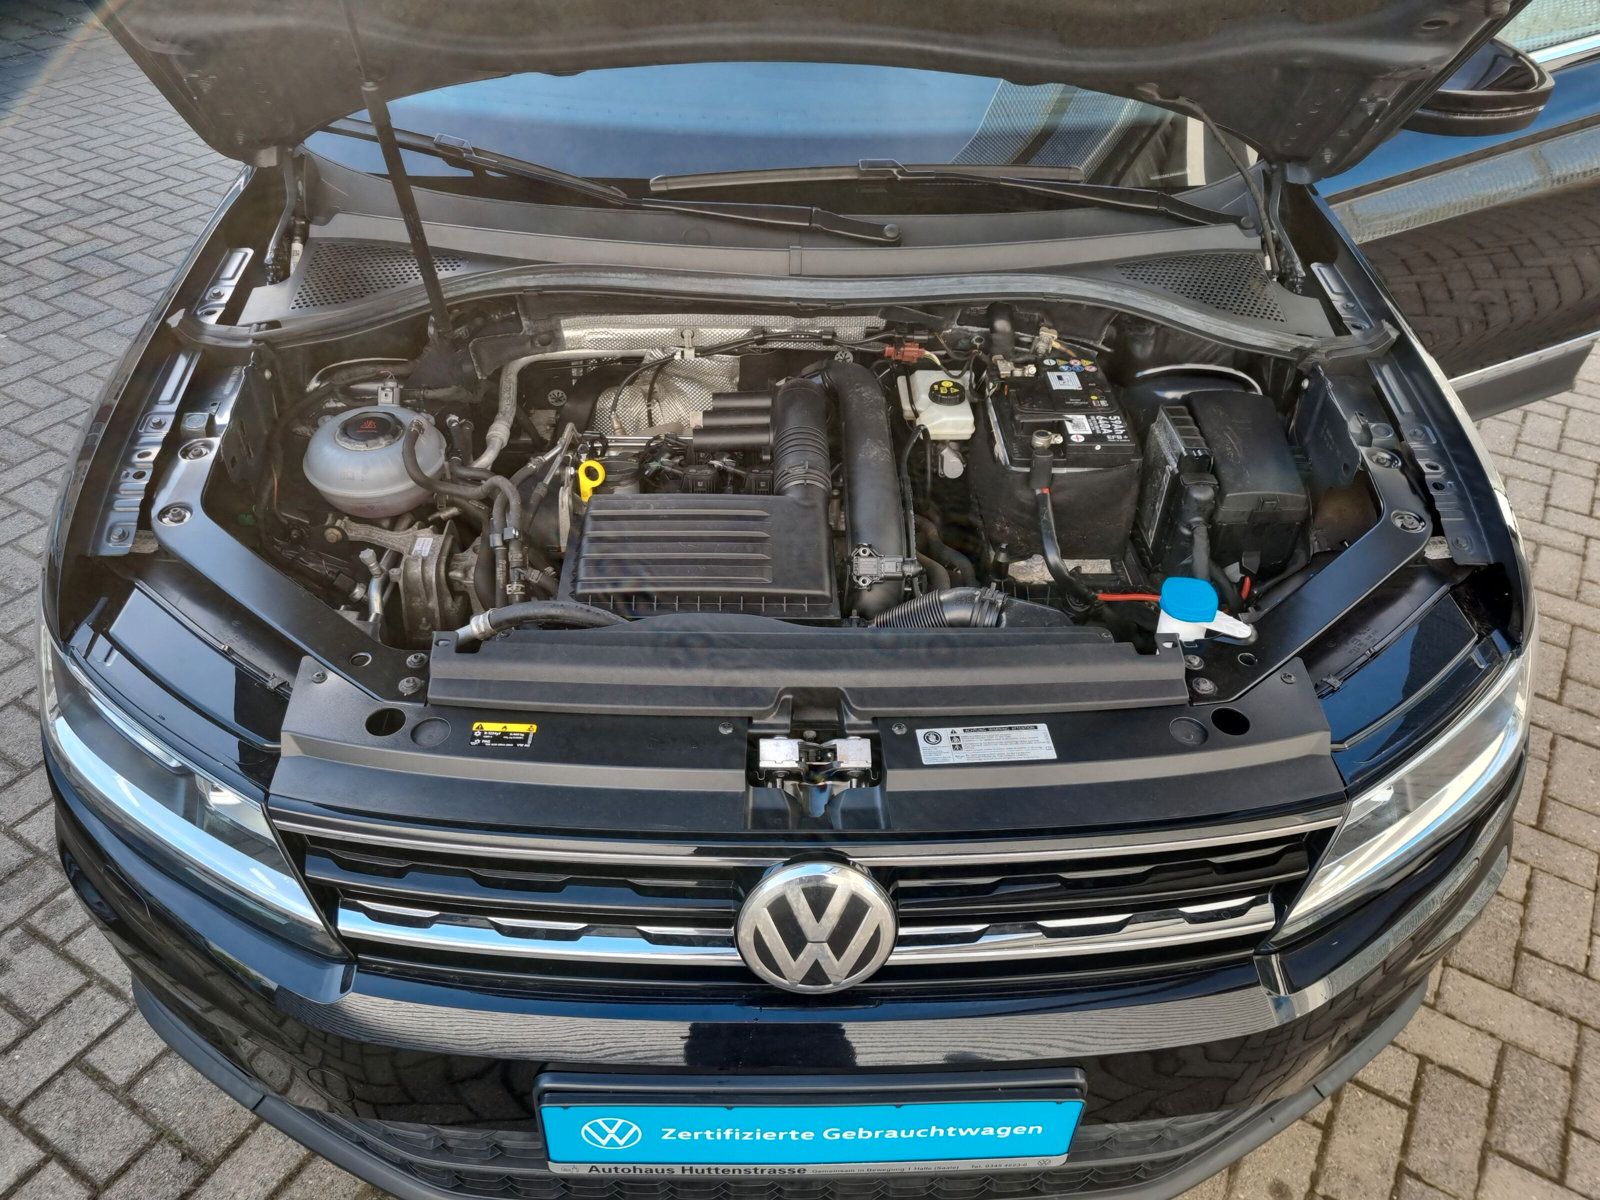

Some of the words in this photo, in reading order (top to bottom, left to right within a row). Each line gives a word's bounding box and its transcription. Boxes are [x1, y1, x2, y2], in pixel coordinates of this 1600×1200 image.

[661, 1127, 815, 1142] Zertifizierte
[822, 1123, 1044, 1141] Gebrauchtwagen
[588, 1165, 675, 1174] Autohaus
[681, 1165, 807, 1175] Huttenstrasse
